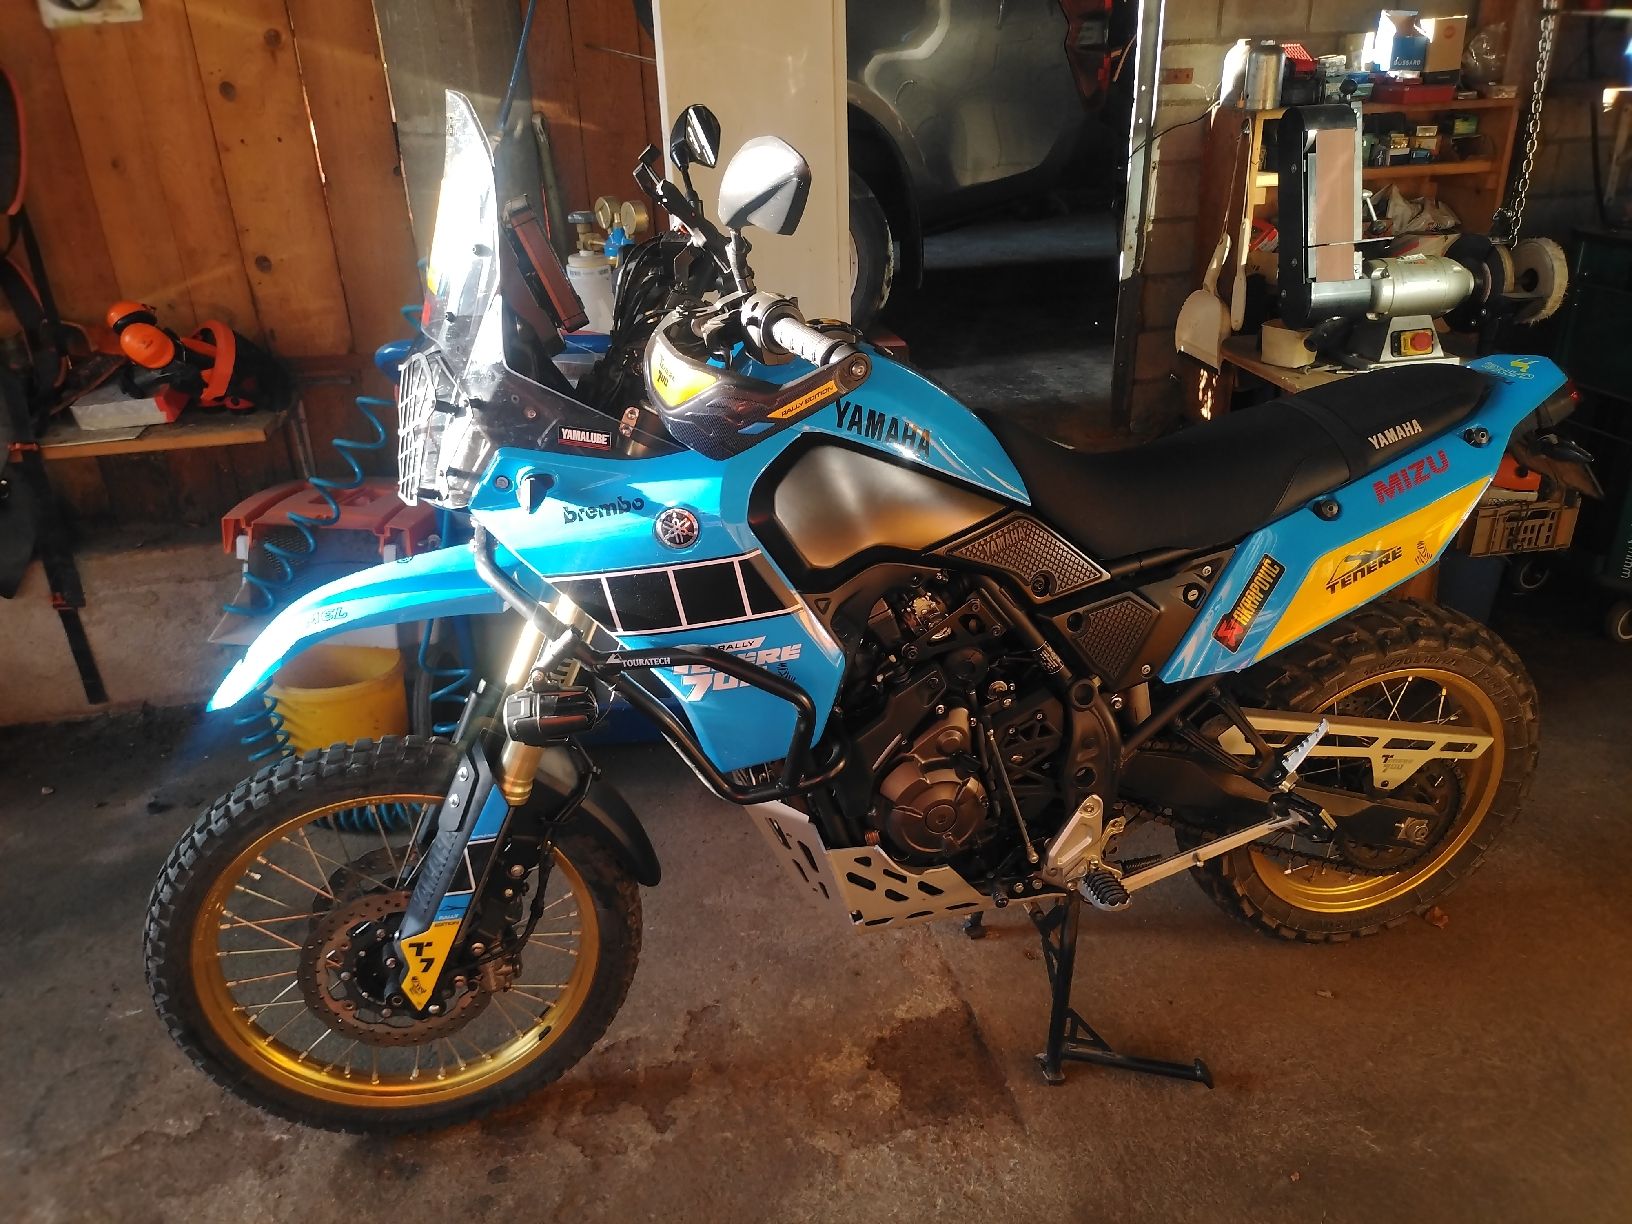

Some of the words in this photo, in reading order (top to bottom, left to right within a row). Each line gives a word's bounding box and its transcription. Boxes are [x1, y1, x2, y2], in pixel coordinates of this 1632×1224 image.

[781, 401, 804, 417] RALLY
[804, 385, 834, 405] EDITION
[561, 428, 611, 445] YAMALUBE
[835, 398, 931, 458] YAMAHA
[1367, 419, 1422, 449] YAMAHA
[1372, 449, 1450, 504] MIZU
[563, 496, 645, 524] brembo
[983, 527, 1026, 557] YAMAHA
[718, 640, 755, 651] RALLY
[622, 656, 671, 668] TOURATECH
